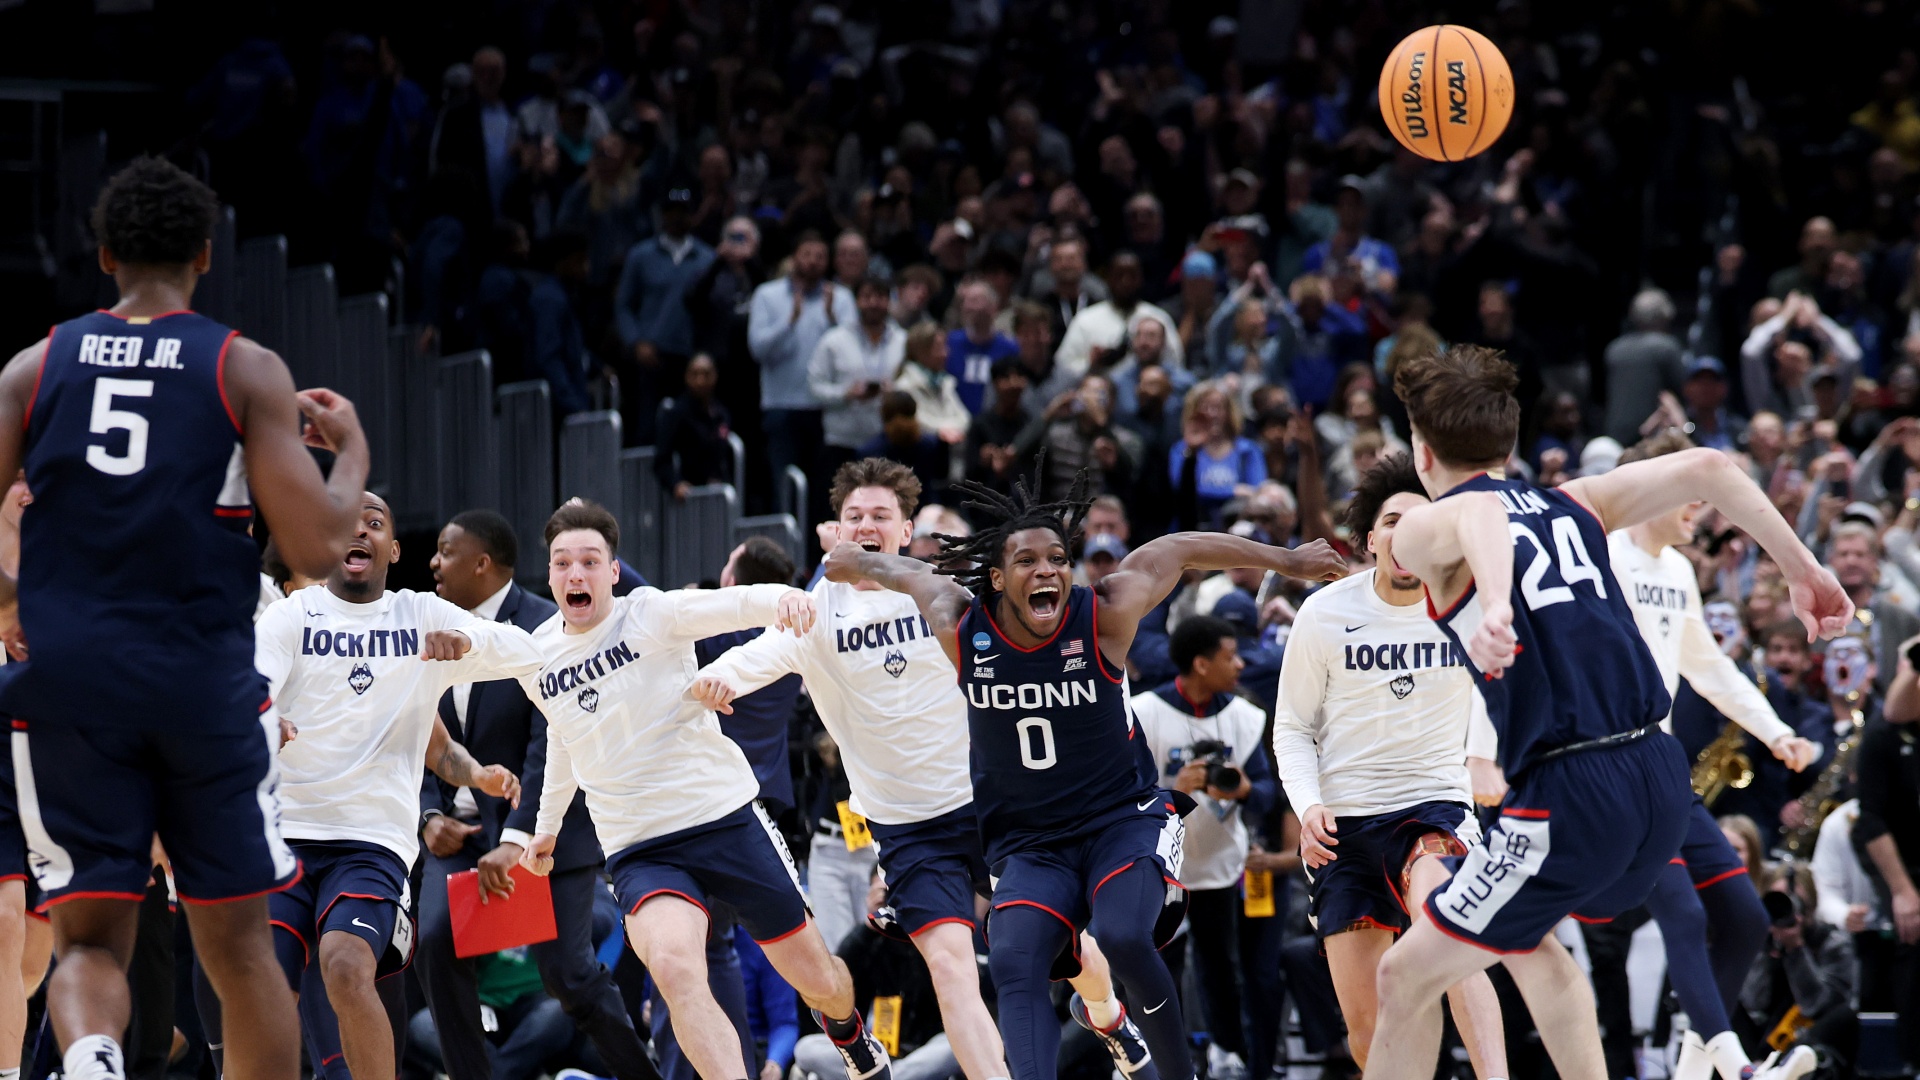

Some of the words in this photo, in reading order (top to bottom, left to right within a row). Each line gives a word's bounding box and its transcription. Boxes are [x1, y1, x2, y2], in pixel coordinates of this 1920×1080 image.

[1402, 51, 1429, 139] Wilson
[1446, 60, 1468, 125] NCAA
[78, 333, 144, 368] REED
[144, 337, 184, 370] JR.
[86, 376, 154, 476] 5
[1508, 515, 1608, 612] 24
[1635, 583, 1665, 607] LOCK
[302, 626, 365, 658] LOCK
[368, 629, 390, 657] IT
[836, 621, 895, 653] LOCK
[894, 616, 916, 643] IT
[918, 613, 936, 638] I
[539, 661, 586, 701] LOCK
[584, 652, 606, 681] IT
[604, 640, 640, 671] IN.
[1345, 643, 1409, 672] LOCK
[1414, 642, 1436, 669] IT
[967, 679, 1097, 710] UCONN
[1016, 716, 1057, 770] 0
